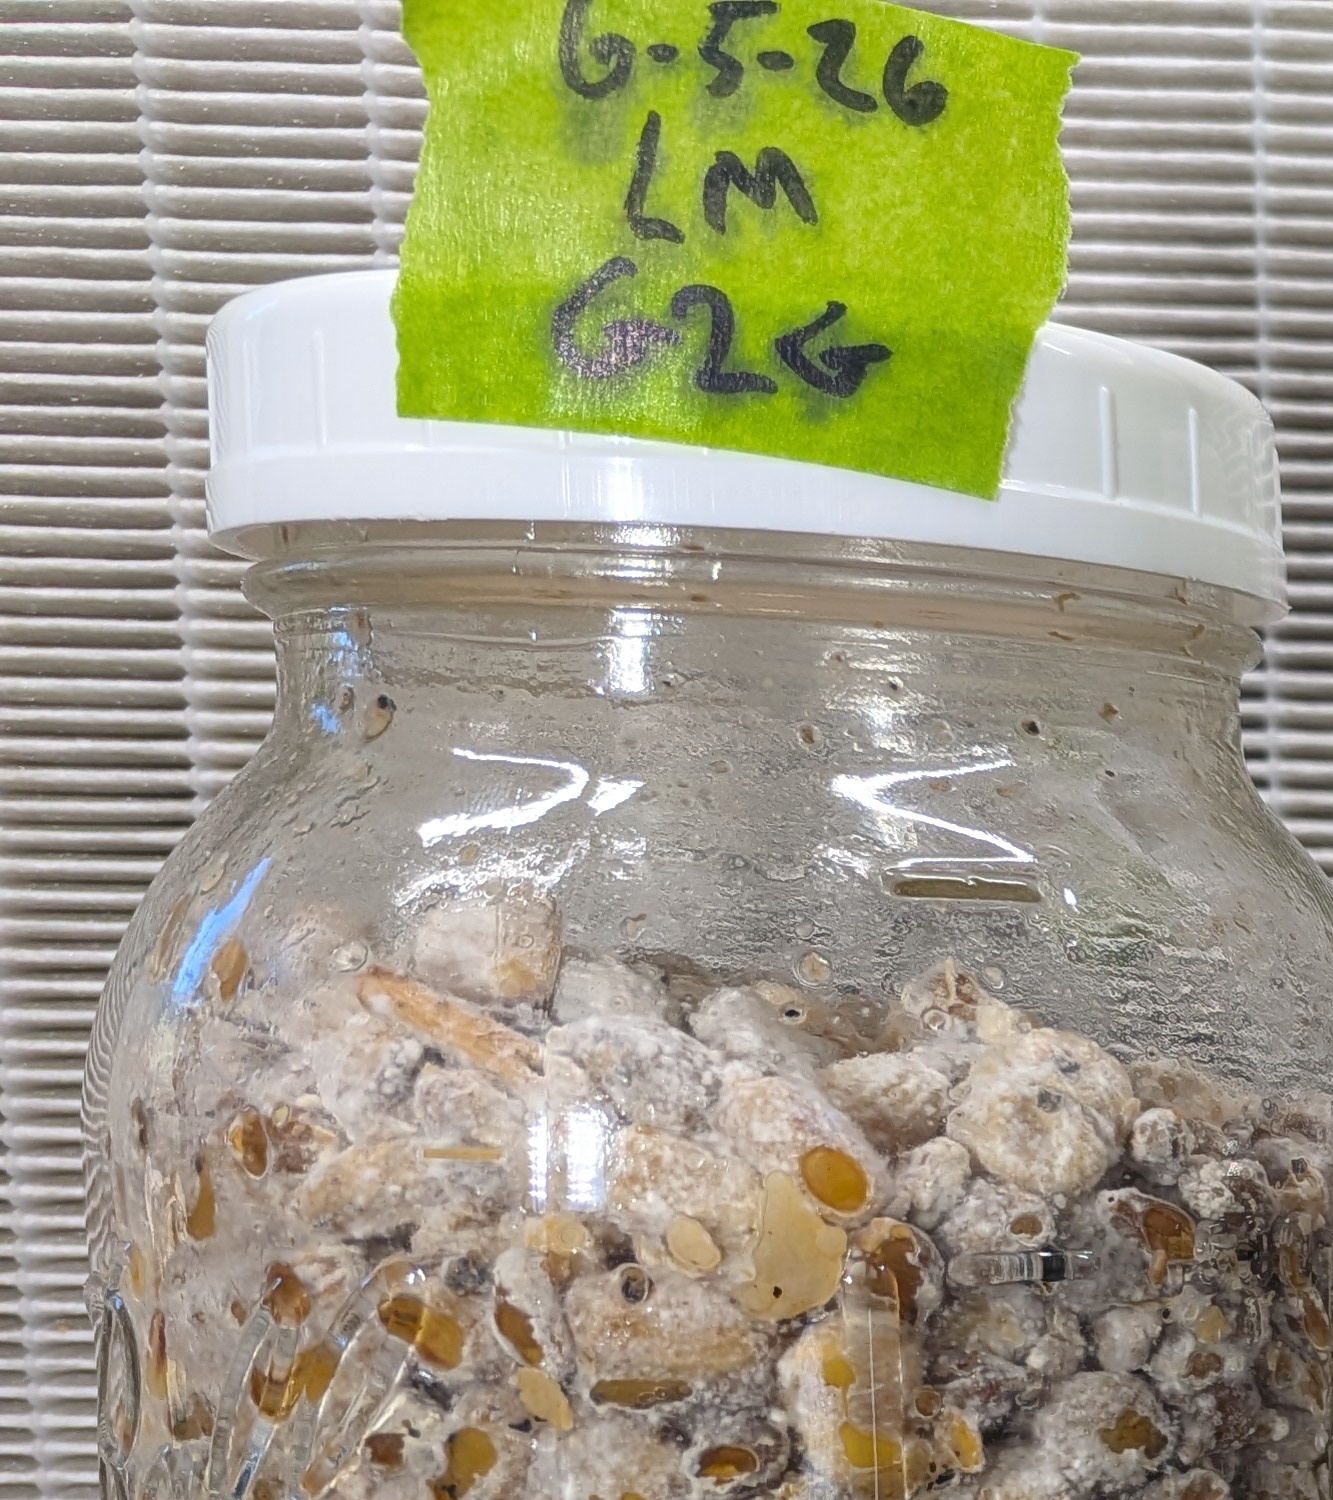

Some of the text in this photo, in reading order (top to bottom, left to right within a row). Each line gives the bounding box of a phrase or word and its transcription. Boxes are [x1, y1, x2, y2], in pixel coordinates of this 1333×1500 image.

[560, 0, 949, 127] 6-5-26
[625, 110, 818, 244] LM
[550, 255, 900, 400] G2G
